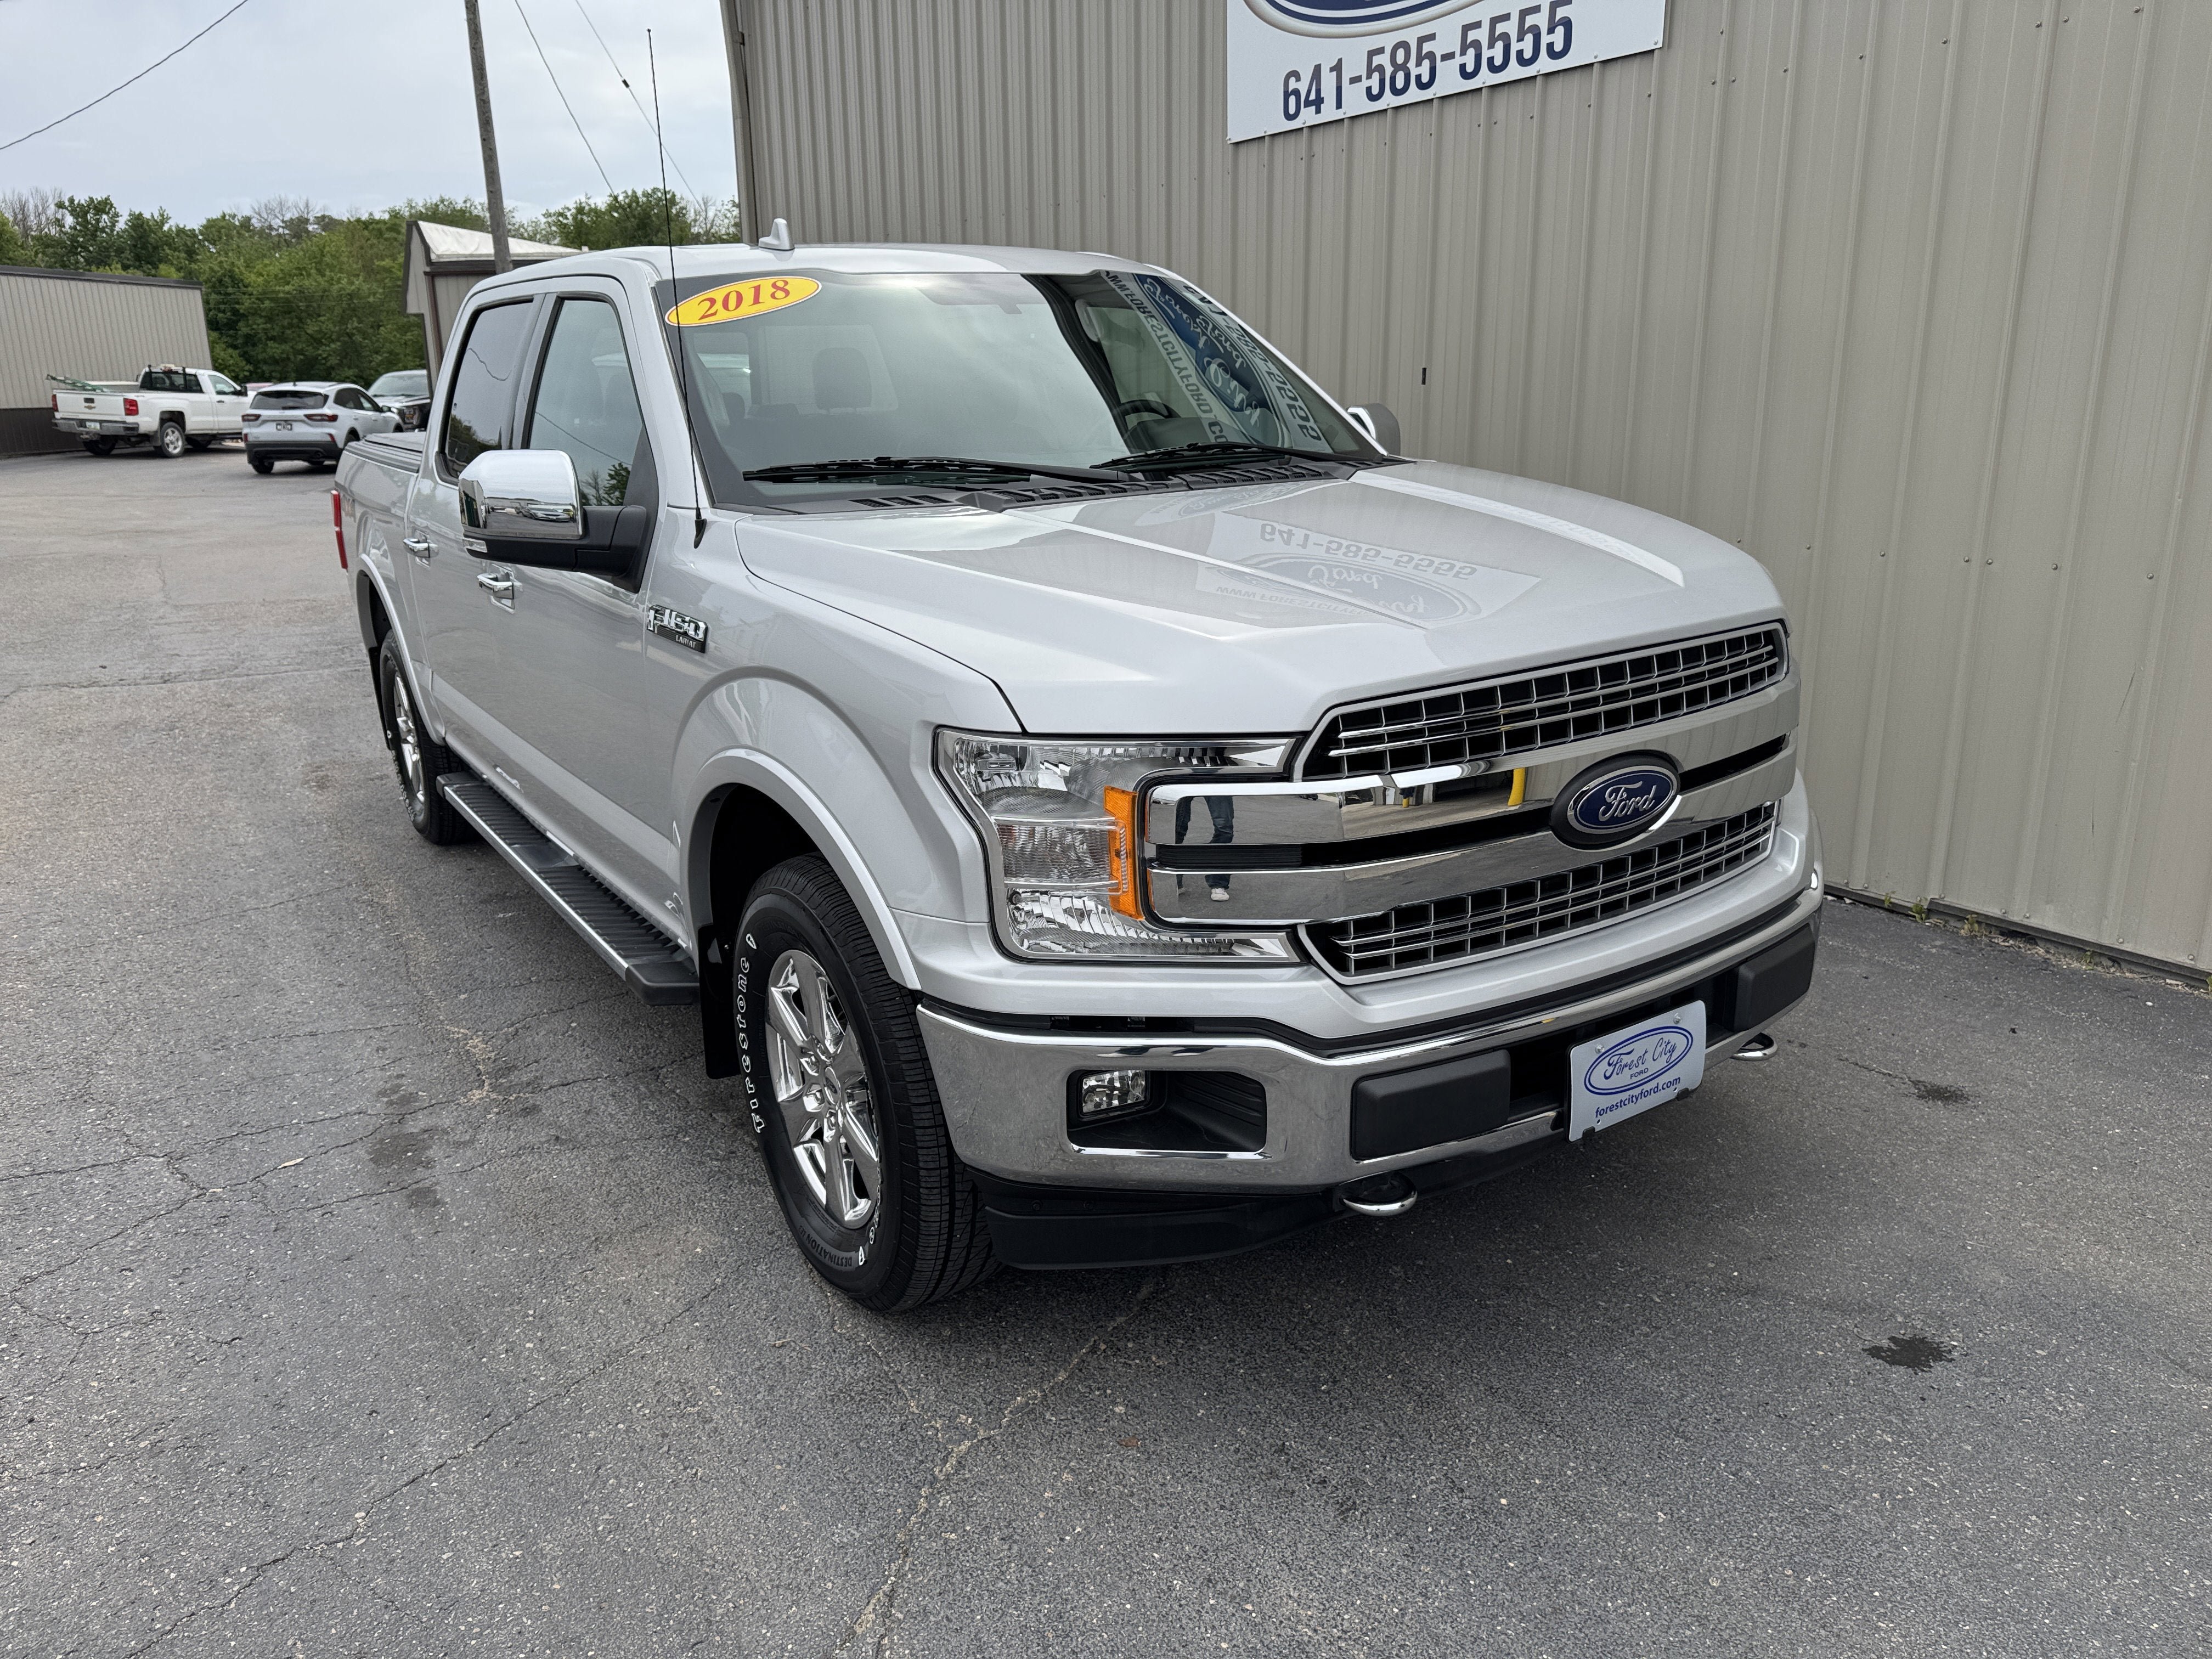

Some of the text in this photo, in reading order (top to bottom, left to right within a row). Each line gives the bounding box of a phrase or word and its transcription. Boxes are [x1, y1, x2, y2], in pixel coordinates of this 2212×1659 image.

[1282, 0, 1573, 122] 641-585-5555
[697, 279, 791, 321] 2018
[675, 634, 697, 648] LARIAT
[1598, 781, 1657, 822] Ford
[1603, 1037, 1677, 1081] Forest City
[1630, 1068, 1649, 1080] FORD
[1595, 1076, 1681, 1119] forestcityford.com
